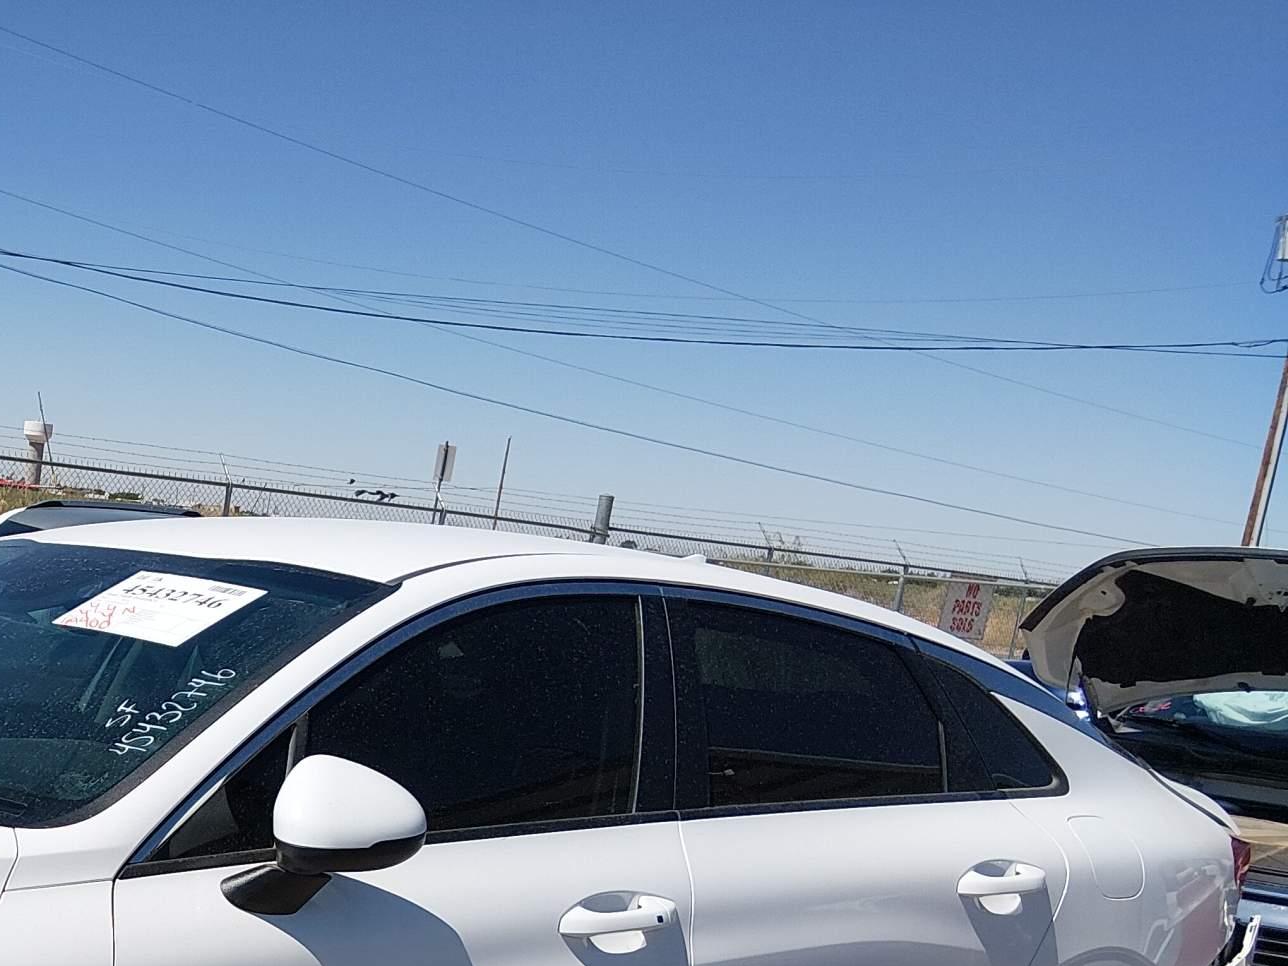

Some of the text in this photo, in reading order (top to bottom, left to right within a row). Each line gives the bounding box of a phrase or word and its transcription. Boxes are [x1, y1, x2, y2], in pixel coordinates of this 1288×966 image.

[122, 583, 226, 609] 45432746
[965, 583, 981, 599] NO
[951, 599, 983, 617] PARTS
[105, 699, 140, 728] SF
[108, 668, 236, 755] 45432746
